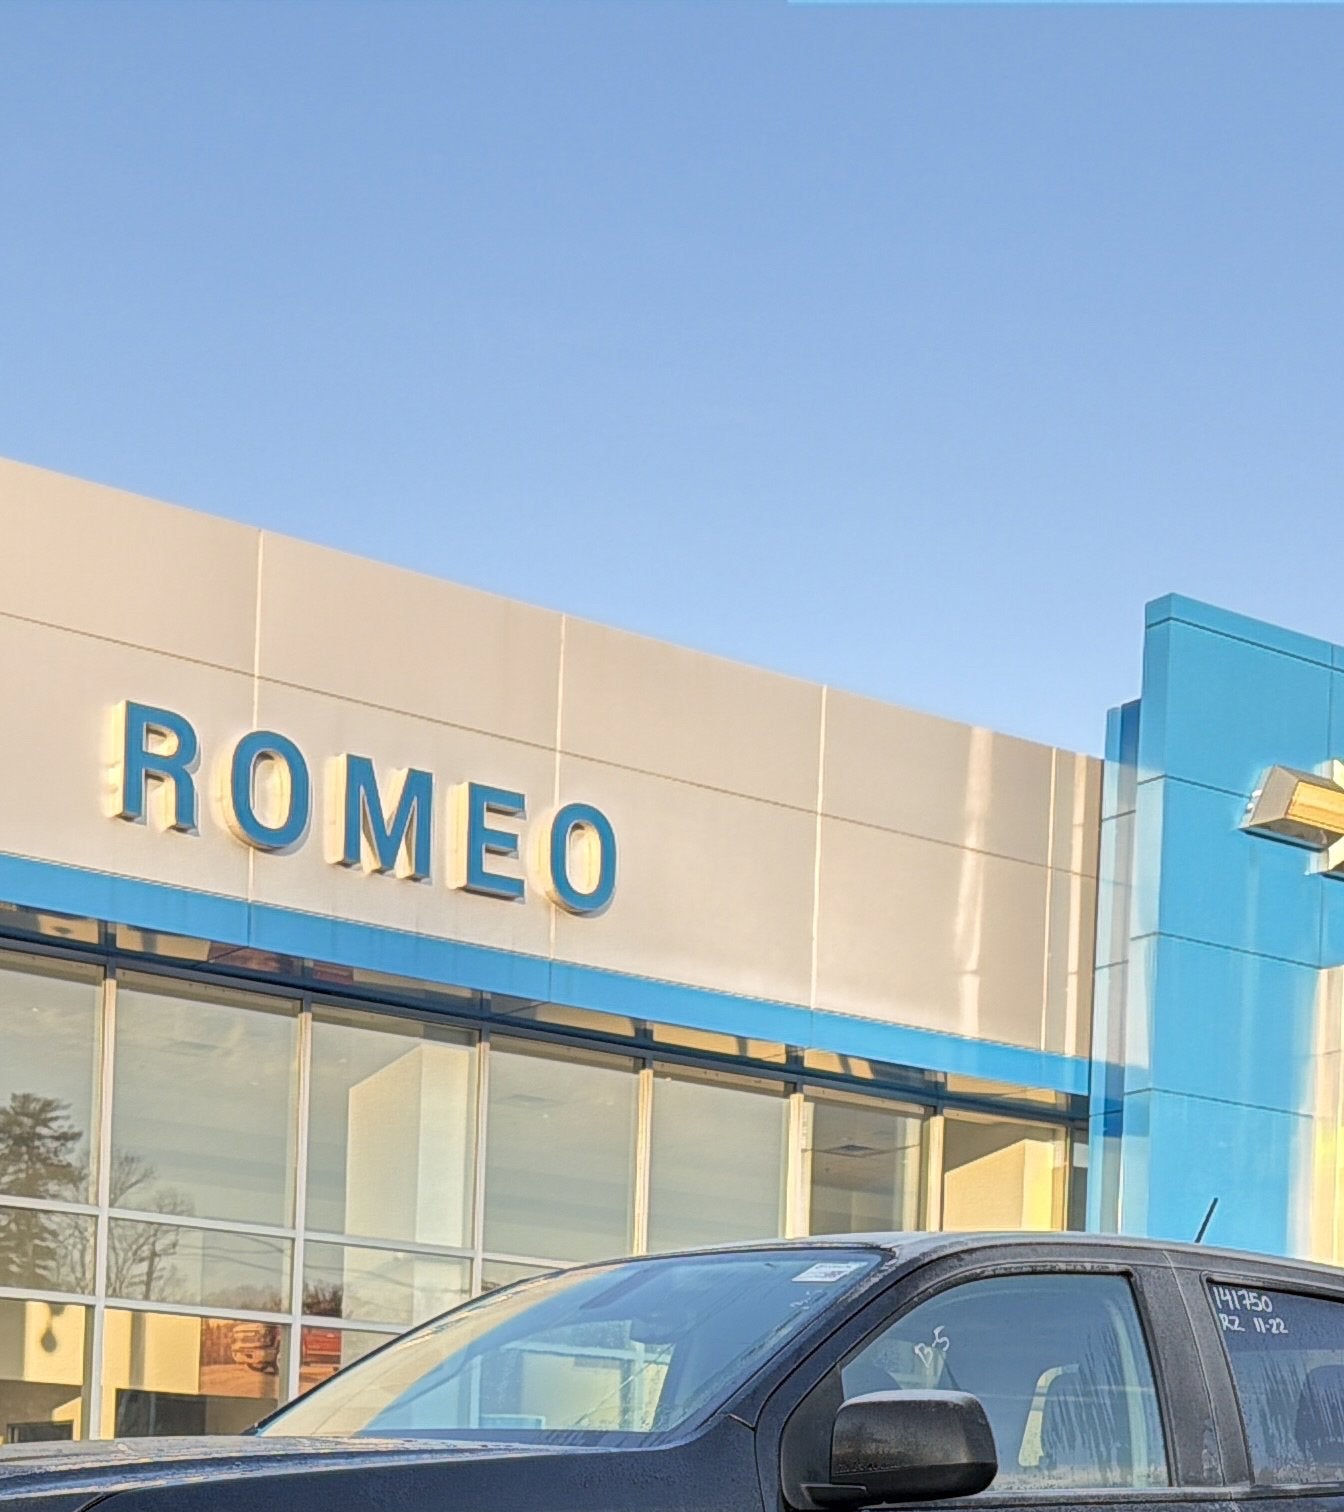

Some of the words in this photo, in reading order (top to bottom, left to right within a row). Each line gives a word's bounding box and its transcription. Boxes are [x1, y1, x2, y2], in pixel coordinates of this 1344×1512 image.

[108, 699, 619, 917] ROMEO
[1213, 1286, 1273, 1313] 141750
[1253, 1316, 1289, 1334] 11-22
